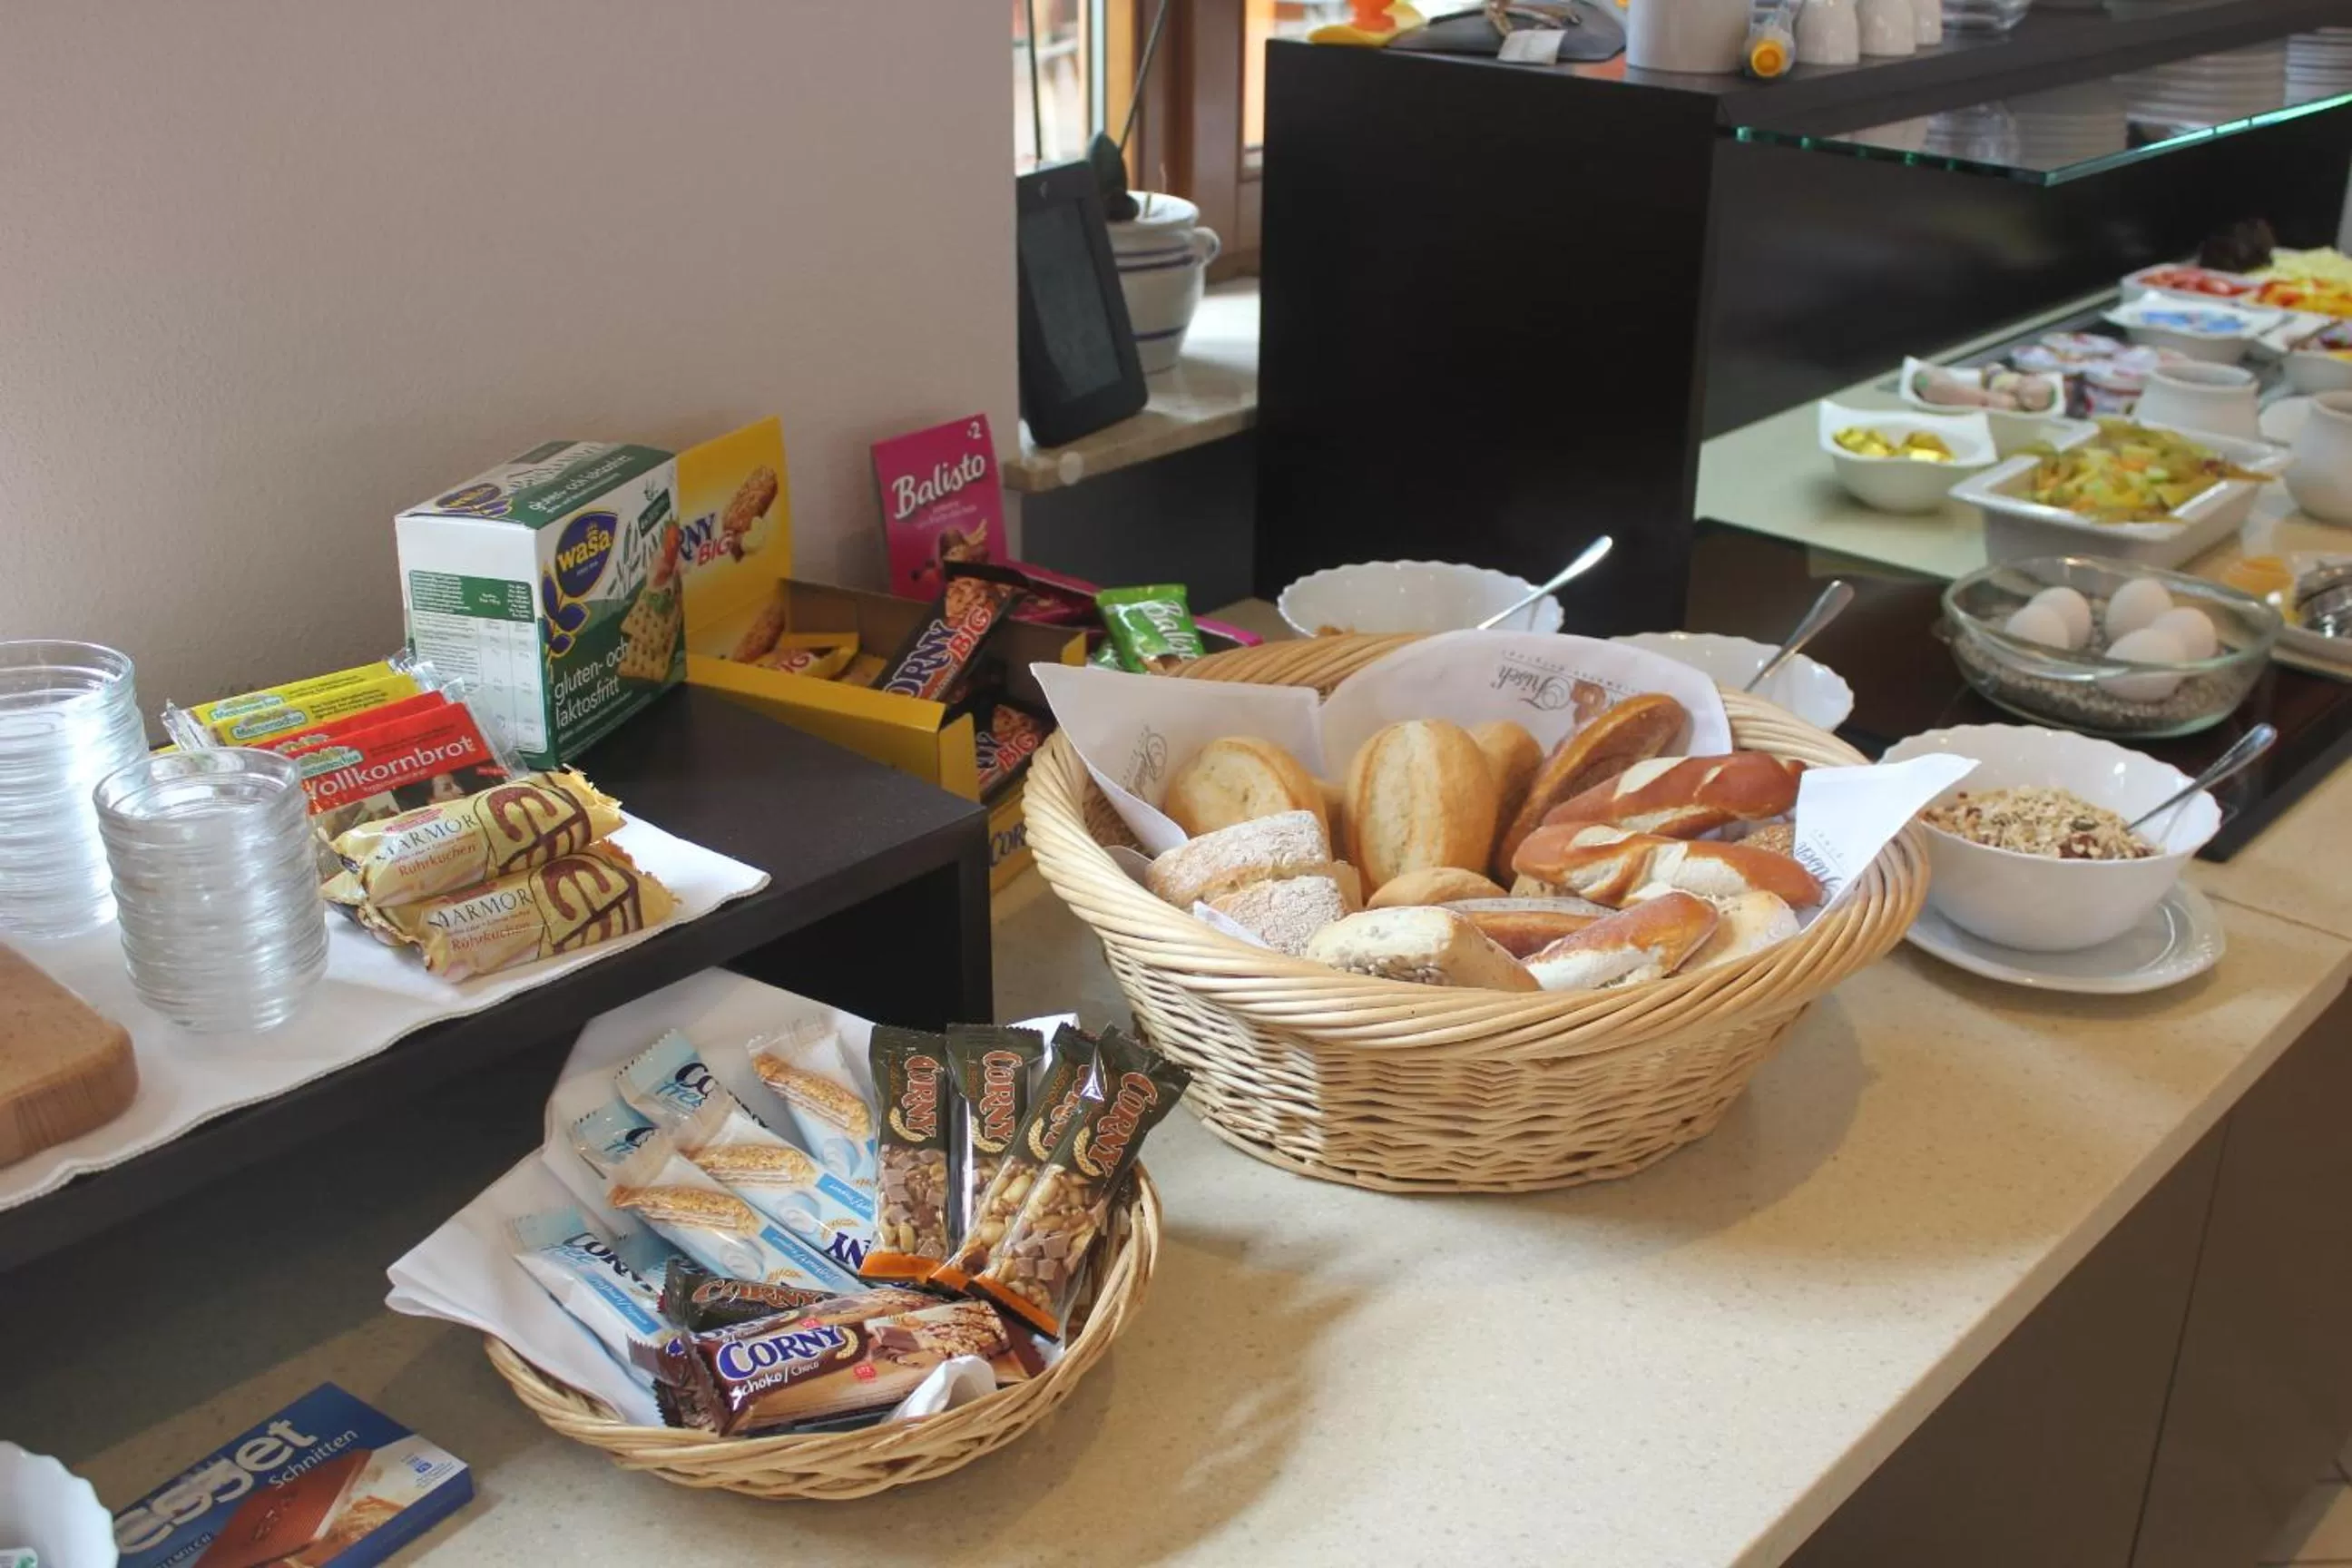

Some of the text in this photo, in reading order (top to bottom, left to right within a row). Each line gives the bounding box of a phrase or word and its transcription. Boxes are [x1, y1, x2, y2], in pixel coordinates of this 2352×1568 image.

[892, 453, 985, 519] Balisto
[558, 528, 612, 572] wasa
[948, 606, 993, 662] BIG
[554, 635, 629, 706] gluten- och
[555, 674, 620, 730] laktosfritt
[303, 734, 475, 798] Vollkornbrot
[995, 729, 1038, 773] BIG
[376, 814, 479, 861] MARMOR
[428, 887, 535, 929] MARMOR
[901, 1054, 945, 1139] CORNY
[979, 1050, 1024, 1144] CORNY
[1088, 1072, 1159, 1178] CORNY
[691, 1279, 829, 1308] CORNY
[717, 1324, 846, 1381] CORNY
[268, 1428, 359, 1490] Schnitten
